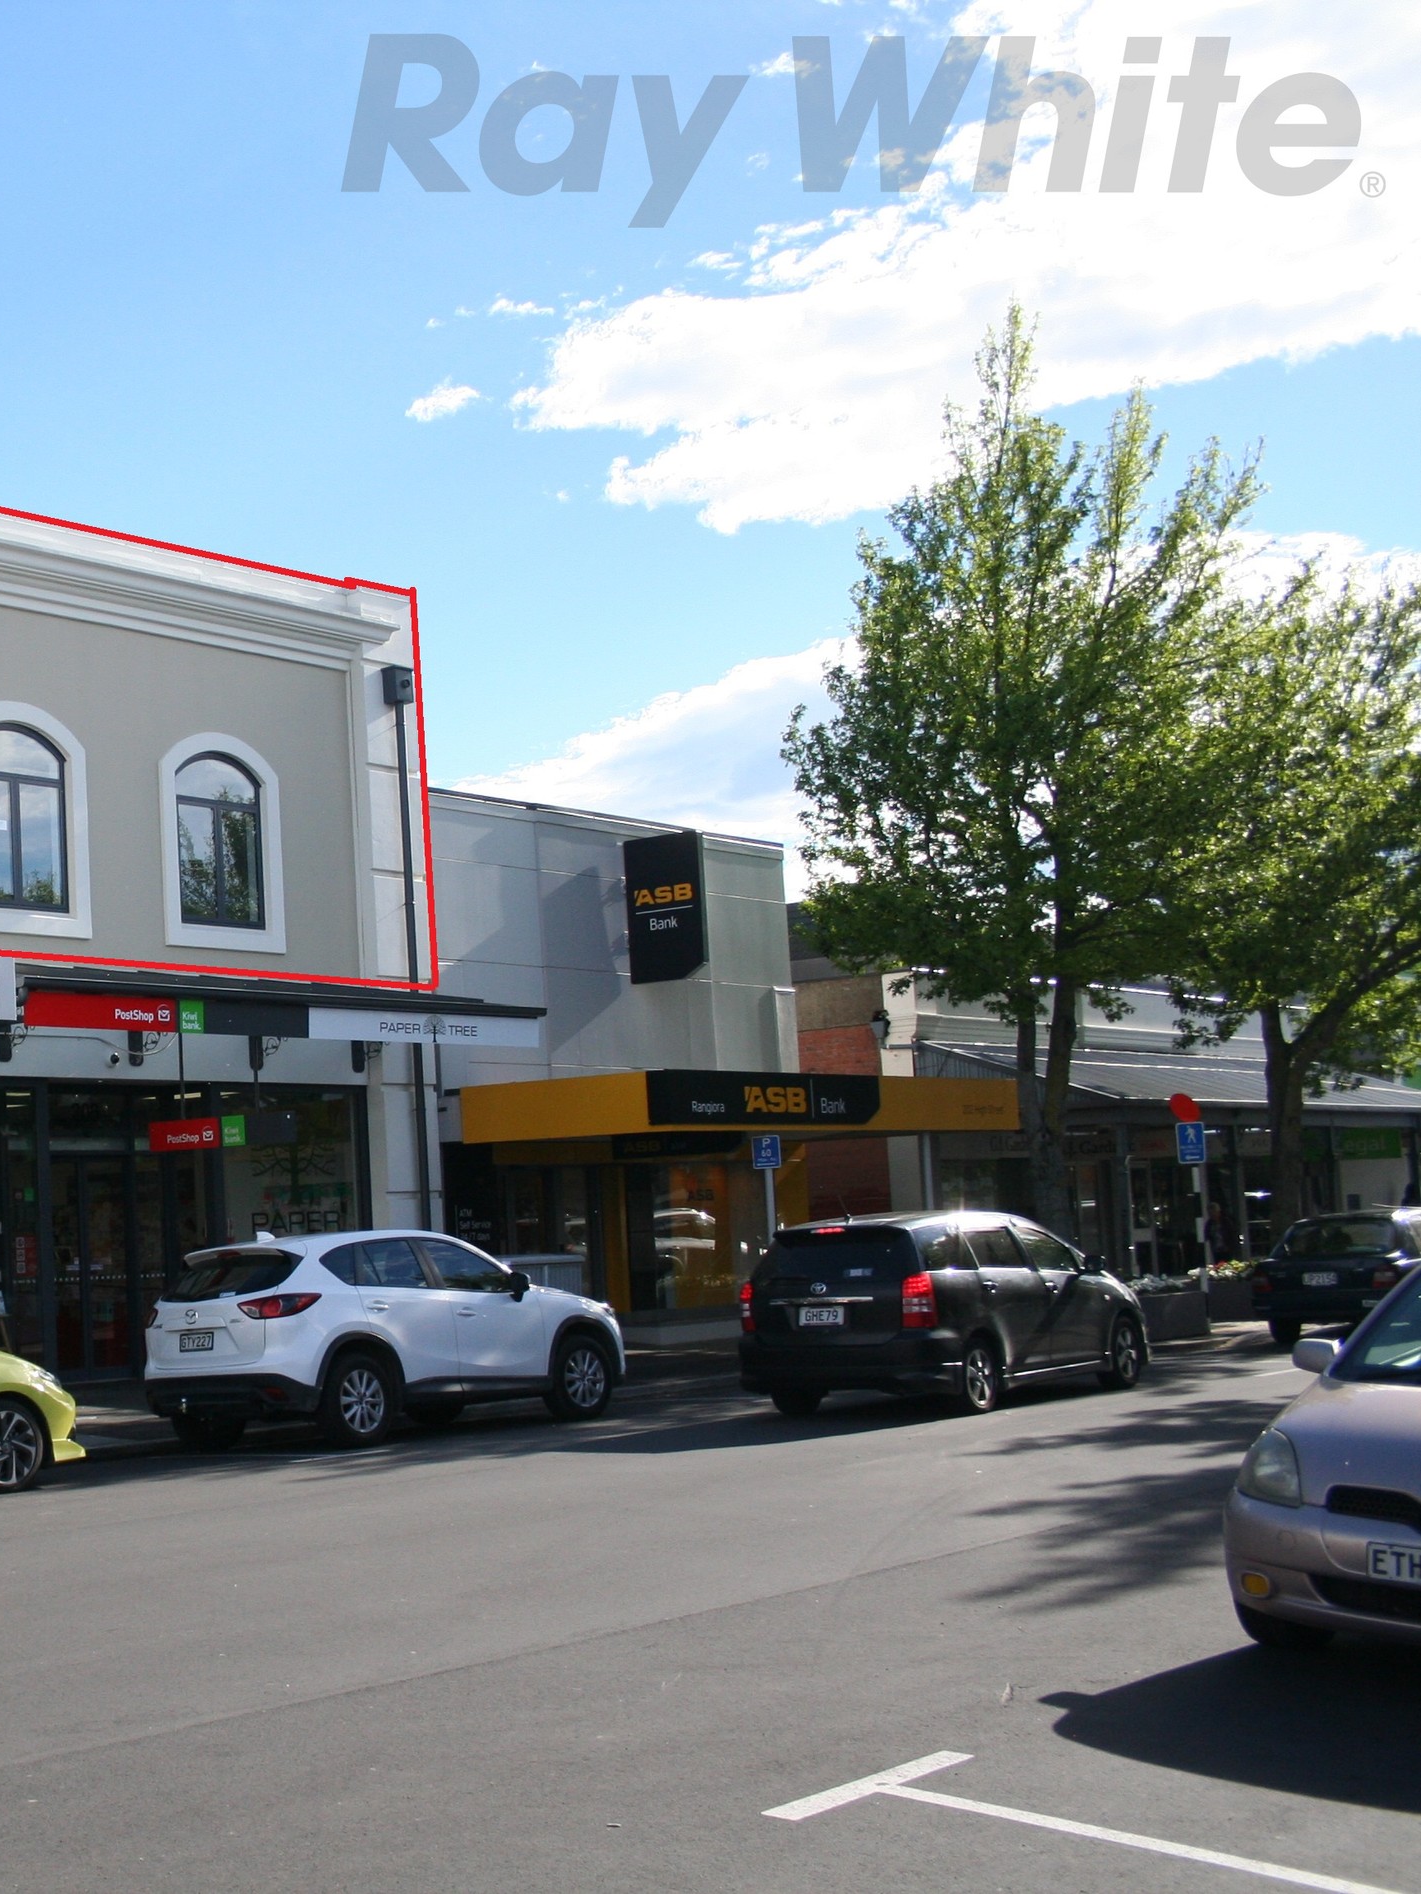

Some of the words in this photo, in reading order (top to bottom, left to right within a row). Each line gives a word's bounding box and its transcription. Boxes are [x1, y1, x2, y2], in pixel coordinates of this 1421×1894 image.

[634, 883, 693, 906] ASB
[649, 916, 679, 931] Bank
[114, 1008, 154, 1023] PostShop
[182, 1011, 199, 1021] Kiwi
[380, 1021, 421, 1035] PAPER
[449, 1025, 478, 1038] TREE
[691, 1101, 725, 1115] Rangiora
[744, 1086, 807, 1114] ASB
[820, 1097, 847, 1114] Bank
[224, 1126, 240, 1136] Kiwi
[167, 1133, 200, 1145] PostShop
[762, 1137, 771, 1148] P
[761, 1149, 772, 1157] 60
[251, 1210, 341, 1235] PAPER
[804, 1309, 839, 1322] GHE79
[181, 1335, 212, 1348] GTY227
[1372, 1549, 1421, 1578] ETH
